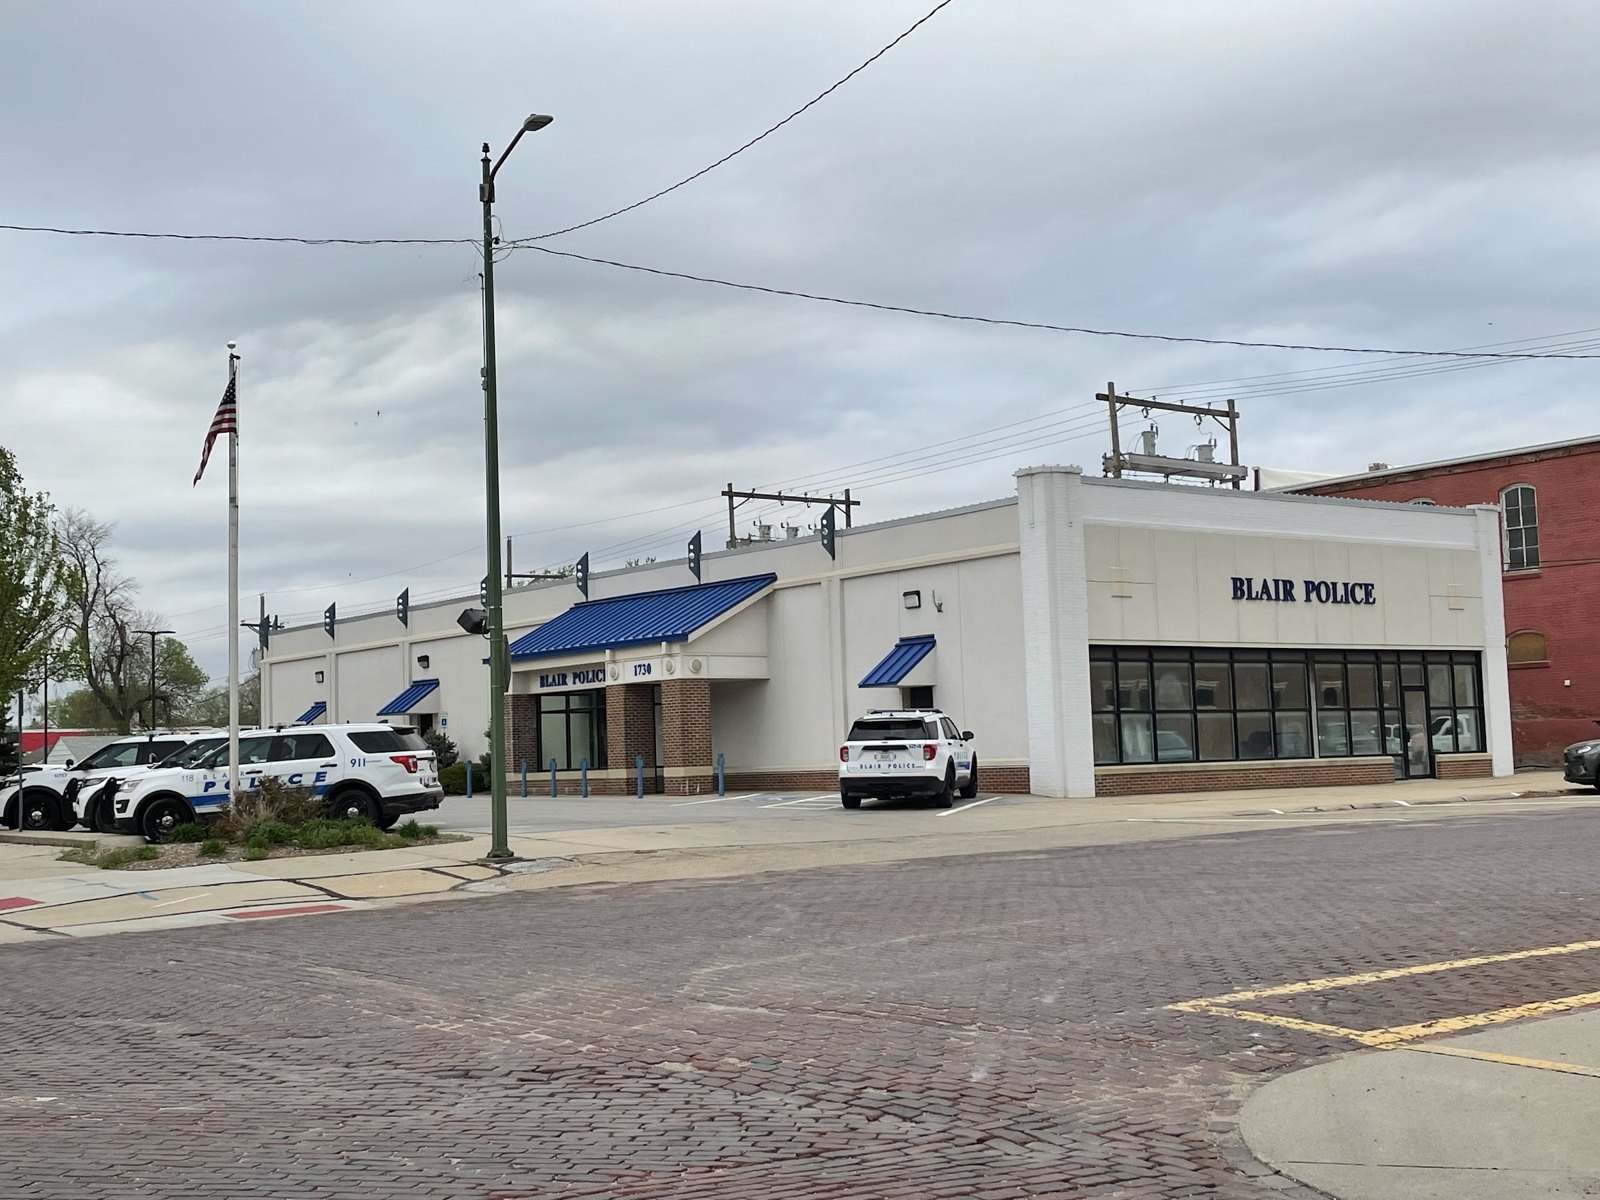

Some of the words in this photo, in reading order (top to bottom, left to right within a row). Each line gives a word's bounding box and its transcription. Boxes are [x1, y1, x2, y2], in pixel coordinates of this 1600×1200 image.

[1231, 577, 1296, 602] BLAIR
[1303, 580, 1376, 605] POLICE
[633, 663, 652, 676] 1730
[539, 673, 568, 688] BLAIR
[350, 757, 366, 768] 911
[887, 762, 916, 770] POLICE
[181, 774, 194, 783] 118
[203, 770, 245, 781] BLAR
